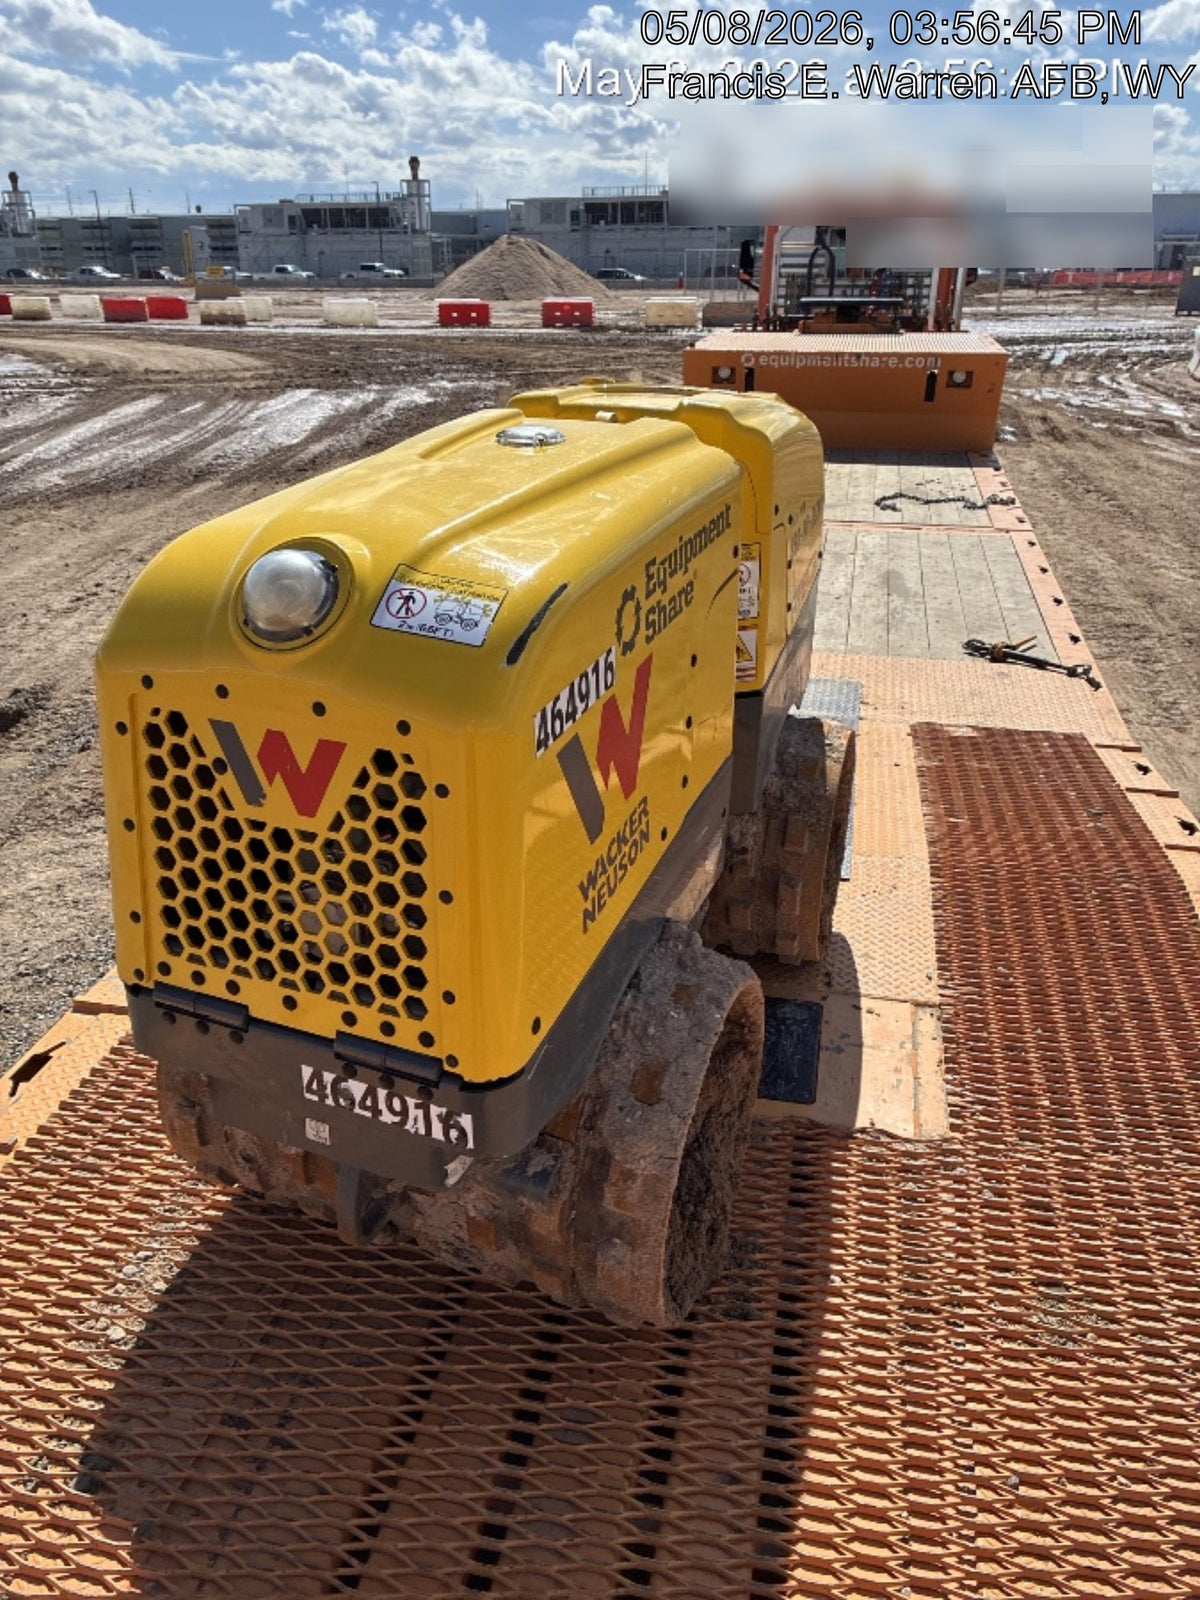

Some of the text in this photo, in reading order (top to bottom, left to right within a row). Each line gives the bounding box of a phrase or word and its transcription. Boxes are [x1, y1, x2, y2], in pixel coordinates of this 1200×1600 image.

[644, 503, 732, 600] Equipment
[644, 579, 695, 644] Share
[536, 651, 615, 753] 464916
[577, 796, 650, 902] WACKER
[582, 819, 651, 935] NEUSON
[304, 1068, 469, 1148] 464916
